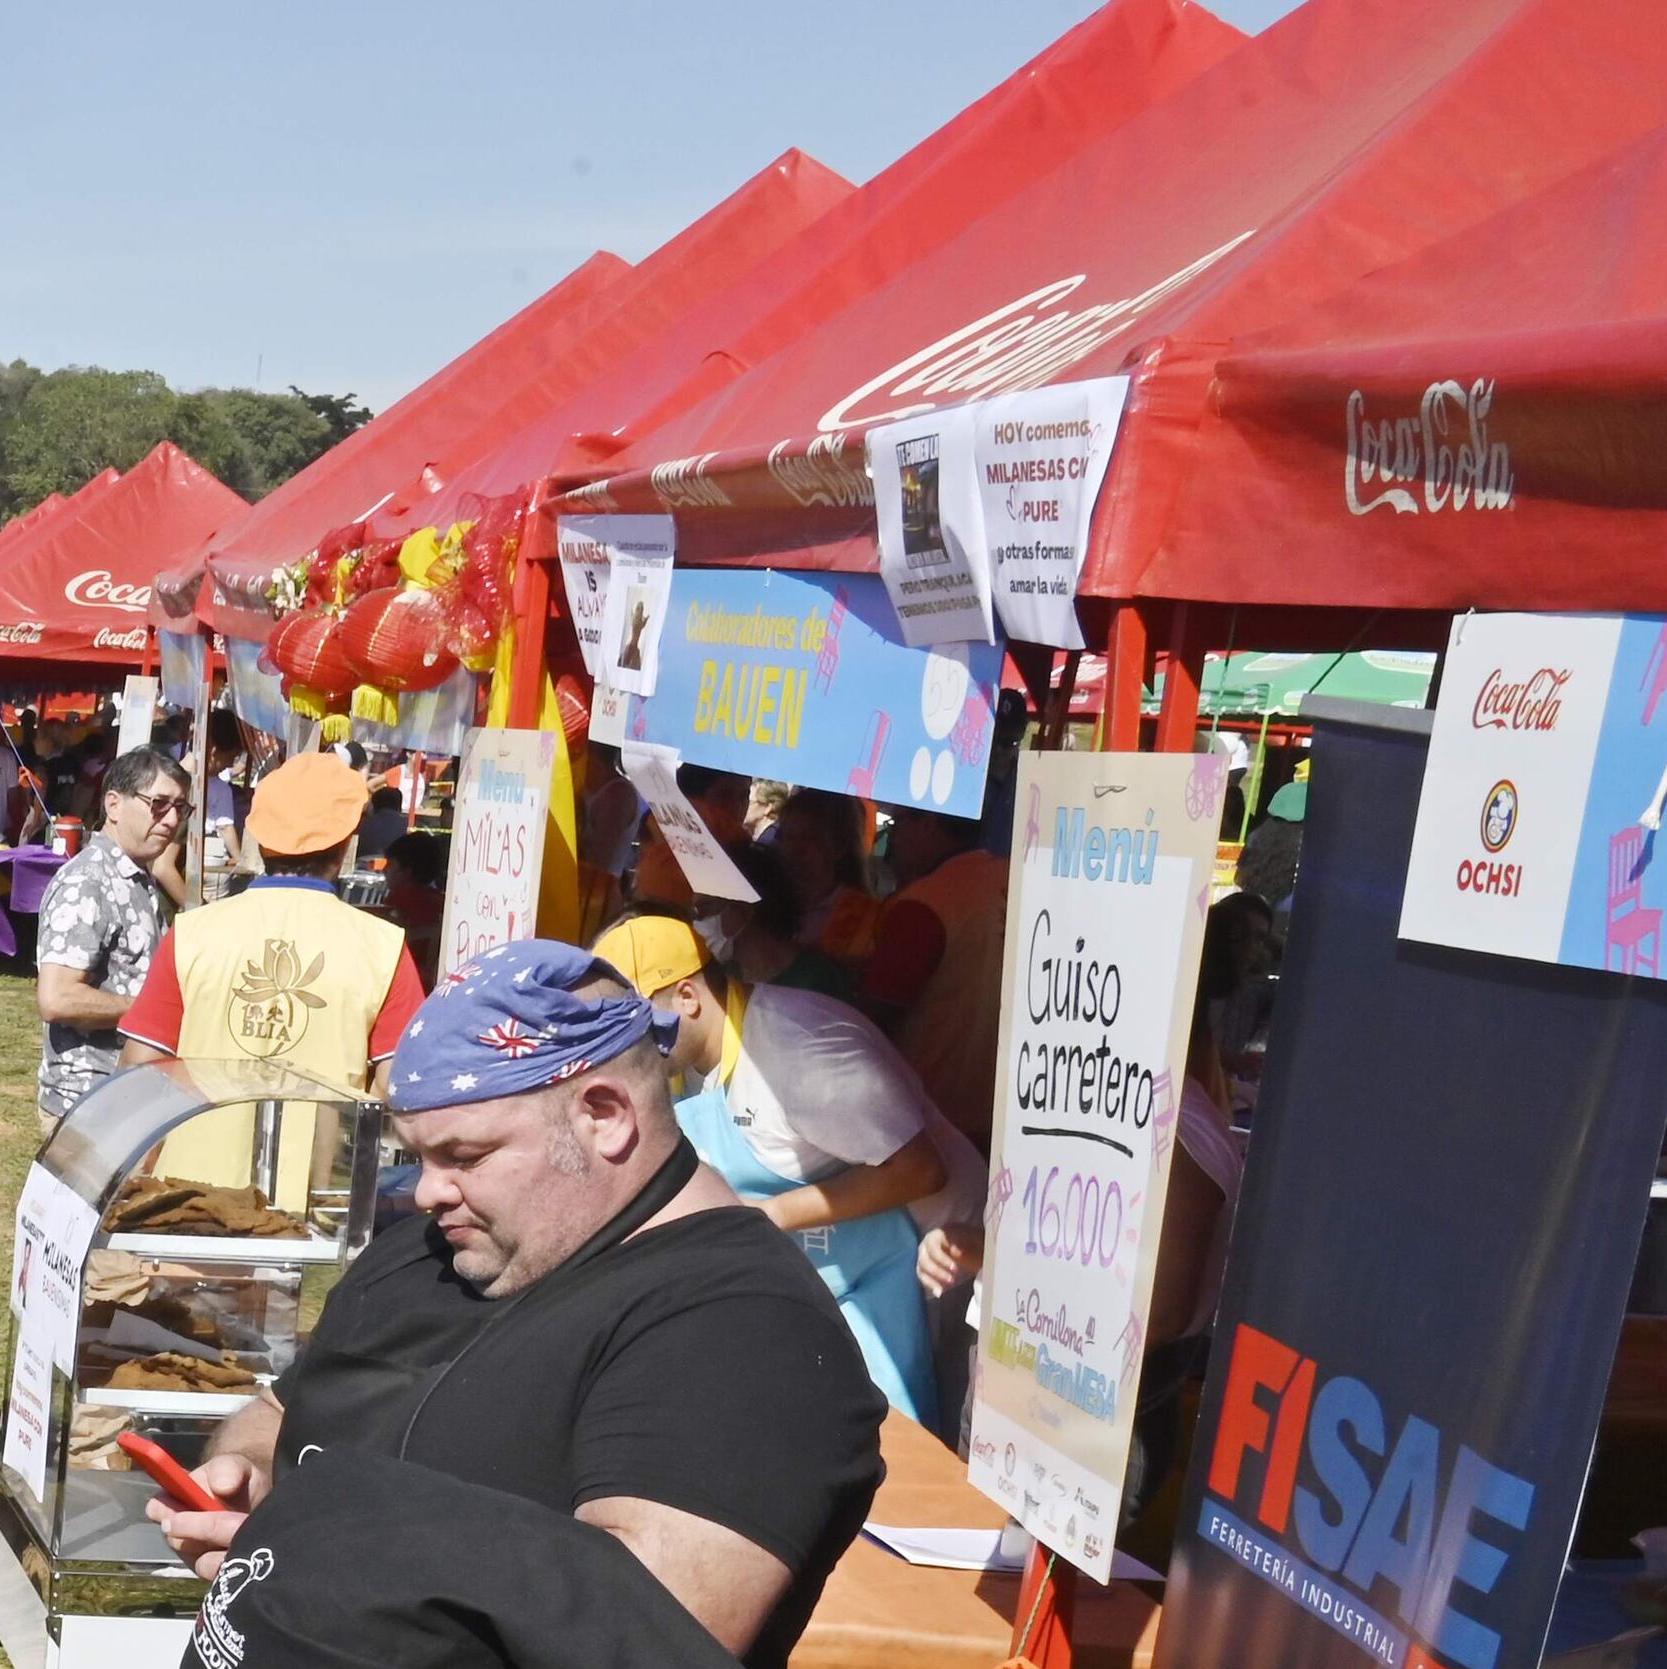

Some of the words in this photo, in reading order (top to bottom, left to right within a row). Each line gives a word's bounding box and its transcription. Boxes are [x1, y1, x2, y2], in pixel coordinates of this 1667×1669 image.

[994, 421, 1024, 445] HOY
[1345, 378, 1514, 515] Coca-Cola
[986, 459, 1066, 485] MILANESAS
[1009, 579, 1036, 595] amar
[1038, 577, 1048, 594] la
[1051, 574, 1068, 595] vida
[685, 599, 796, 651] Colaboradores
[800, 605, 827, 654] de
[693, 658, 808, 749] BAUEN
[1472, 667, 1572, 731] Coca-Cola
[1051, 807, 1159, 885] Menú
[1457, 858, 1523, 897] OCHSI
[1027, 908, 1121, 1027] Guiso
[241, 1019, 292, 1042] BLIA
[1016, 1033, 1154, 1130] carretero
[1022, 1164, 1123, 1269] 16.000
[1027, 1288, 1083, 1357] Comilona
[1209, 1516, 1295, 1592] FERRETERÍA
[1301, 1579, 1396, 1664] INDUSTRIAL
